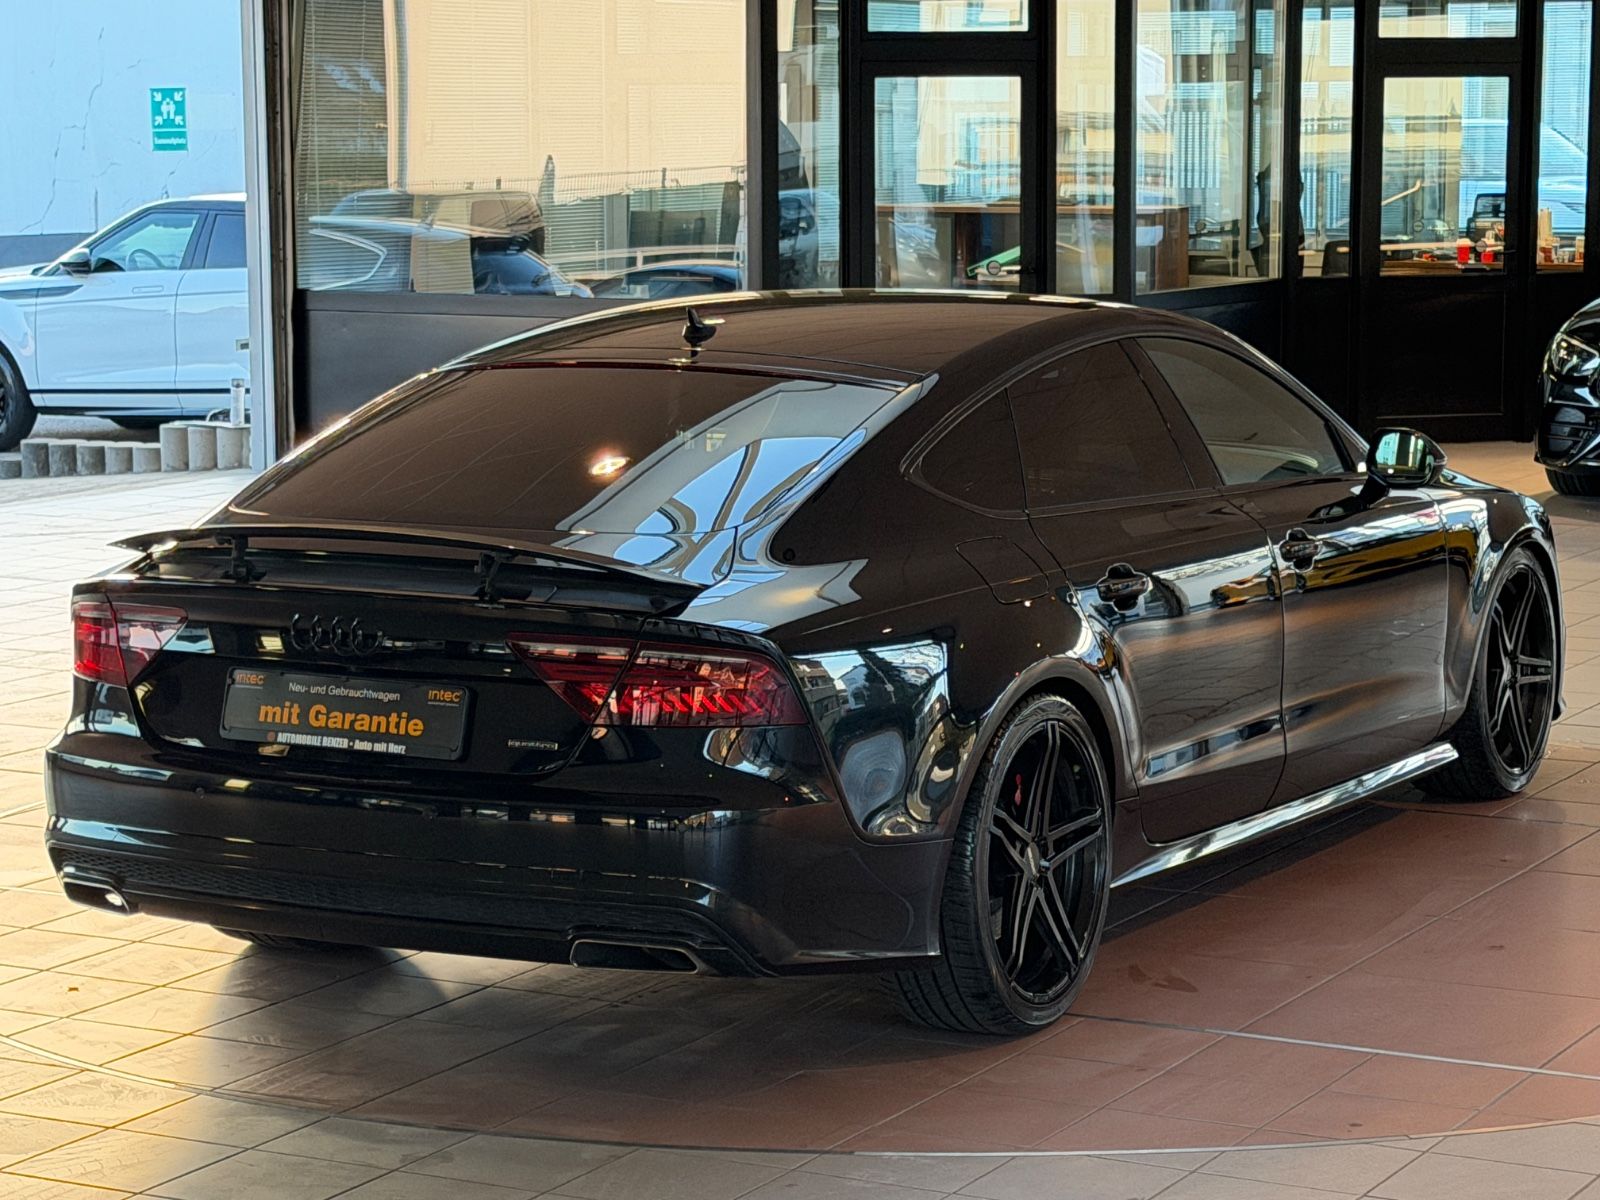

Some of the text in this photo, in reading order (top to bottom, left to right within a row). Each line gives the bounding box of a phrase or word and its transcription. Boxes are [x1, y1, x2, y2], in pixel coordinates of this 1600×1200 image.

[288, 681, 401, 702] Neu- und Gebrauchtwagen
[258, 701, 425, 737] mit Garantie
[276, 732, 322, 746] AUTOMOBILE
[353, 739, 373, 751] Auto
[373, 741, 387, 753] mit
[388, 742, 406, 755] Herz
